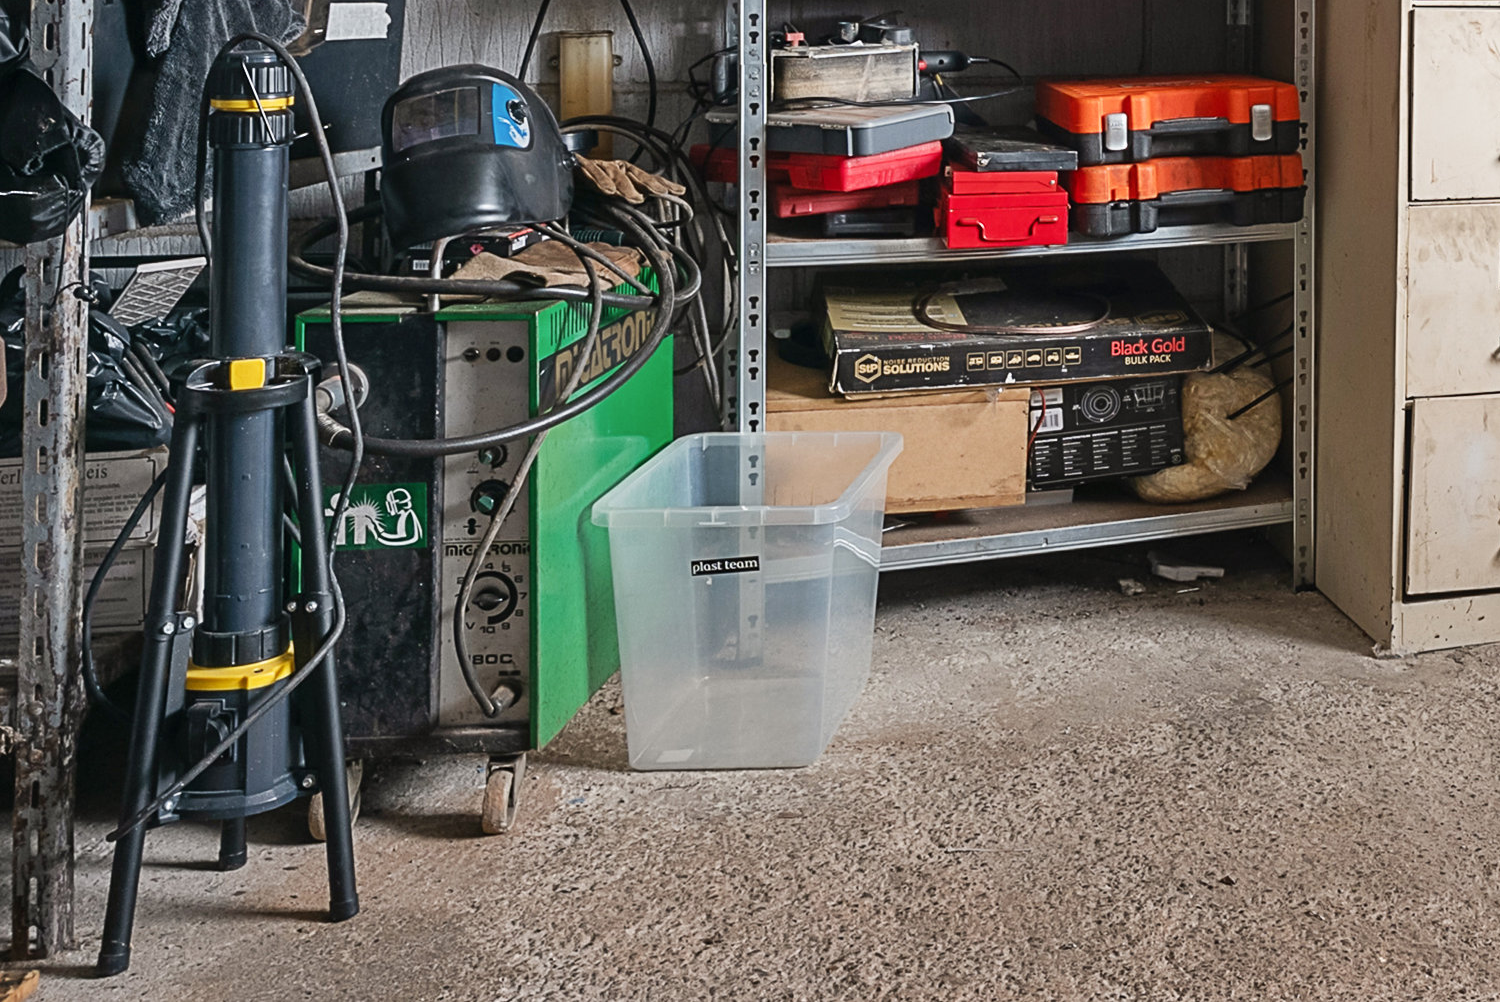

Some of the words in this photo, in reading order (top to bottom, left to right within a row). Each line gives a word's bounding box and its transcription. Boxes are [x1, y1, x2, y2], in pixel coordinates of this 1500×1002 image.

[1111, 338, 1148, 356] Black
[1151, 336, 1185, 353] Gold
[908, 356, 950, 364] REDUCTION
[1125, 355, 1148, 365] BULK
[1150, 354, 1171, 363] PACK
[883, 361, 950, 375] SOLUTIONS
[692, 561, 722, 574] plast
[725, 559, 758, 570] team
